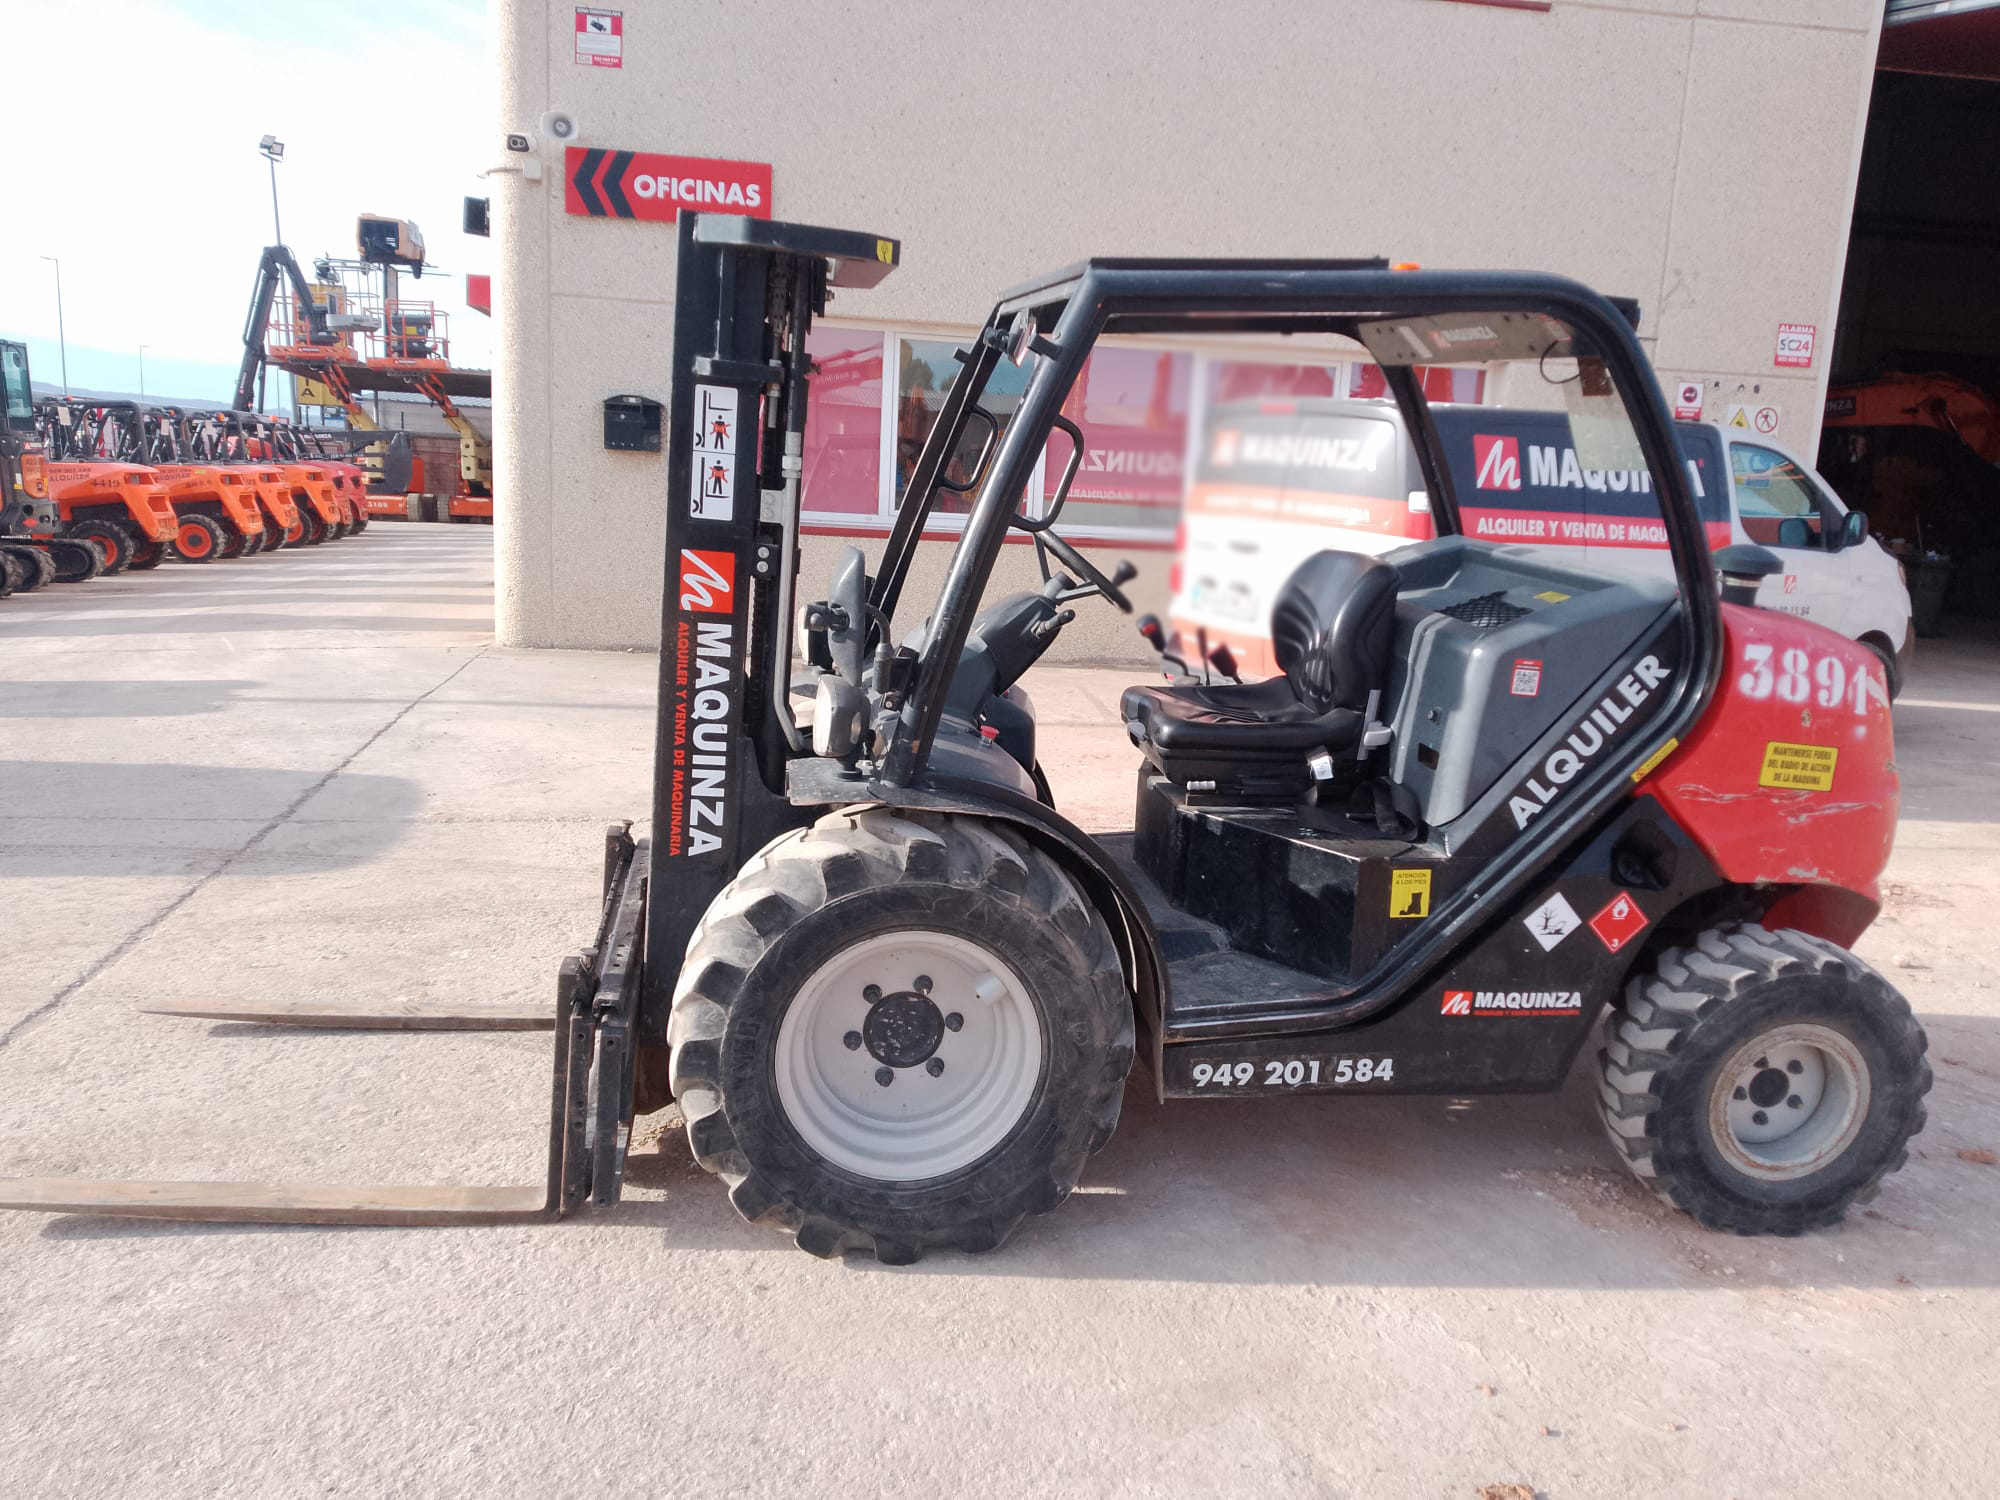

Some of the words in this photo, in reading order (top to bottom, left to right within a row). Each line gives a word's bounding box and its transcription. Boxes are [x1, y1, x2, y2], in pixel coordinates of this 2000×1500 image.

[633, 174, 761, 207] OFICINAS
[1779, 324, 1815, 334] ALARMA
[1242, 434, 1377, 472] MAQUINZA
[1476, 517, 1545, 536] ALQUILER
[1549, 521, 1559, 536] Y
[1562, 522, 1606, 539] VENTA
[1609, 524, 1625, 540] DE
[676, 621, 690, 685] ALQUILER
[1738, 643, 1868, 716] 3891
[676, 690, 688, 701] Y
[673, 703, 687, 745] VENTA
[687, 621, 733, 857] MAQUINZA
[1508, 654, 1673, 831] ALQUILER
[672, 749, 686, 766] DE
[1768, 759, 1779, 768] DEL
[1781, 760, 1800, 770] RADIO
[1801, 762, 1809, 771] DE
[1773, 746, 1812, 759] MANTENERSE
[1774, 772, 1782, 782] DE
[669, 770, 684, 857] MAQUINARIA
[1612, 938, 1619, 948] 3
[1474, 991, 1582, 1010] MAQUINZA
[1192, 1062, 1255, 1087] 949
[1264, 1060, 1320, 1085] 201
[1335, 1058, 1394, 1083] 584
